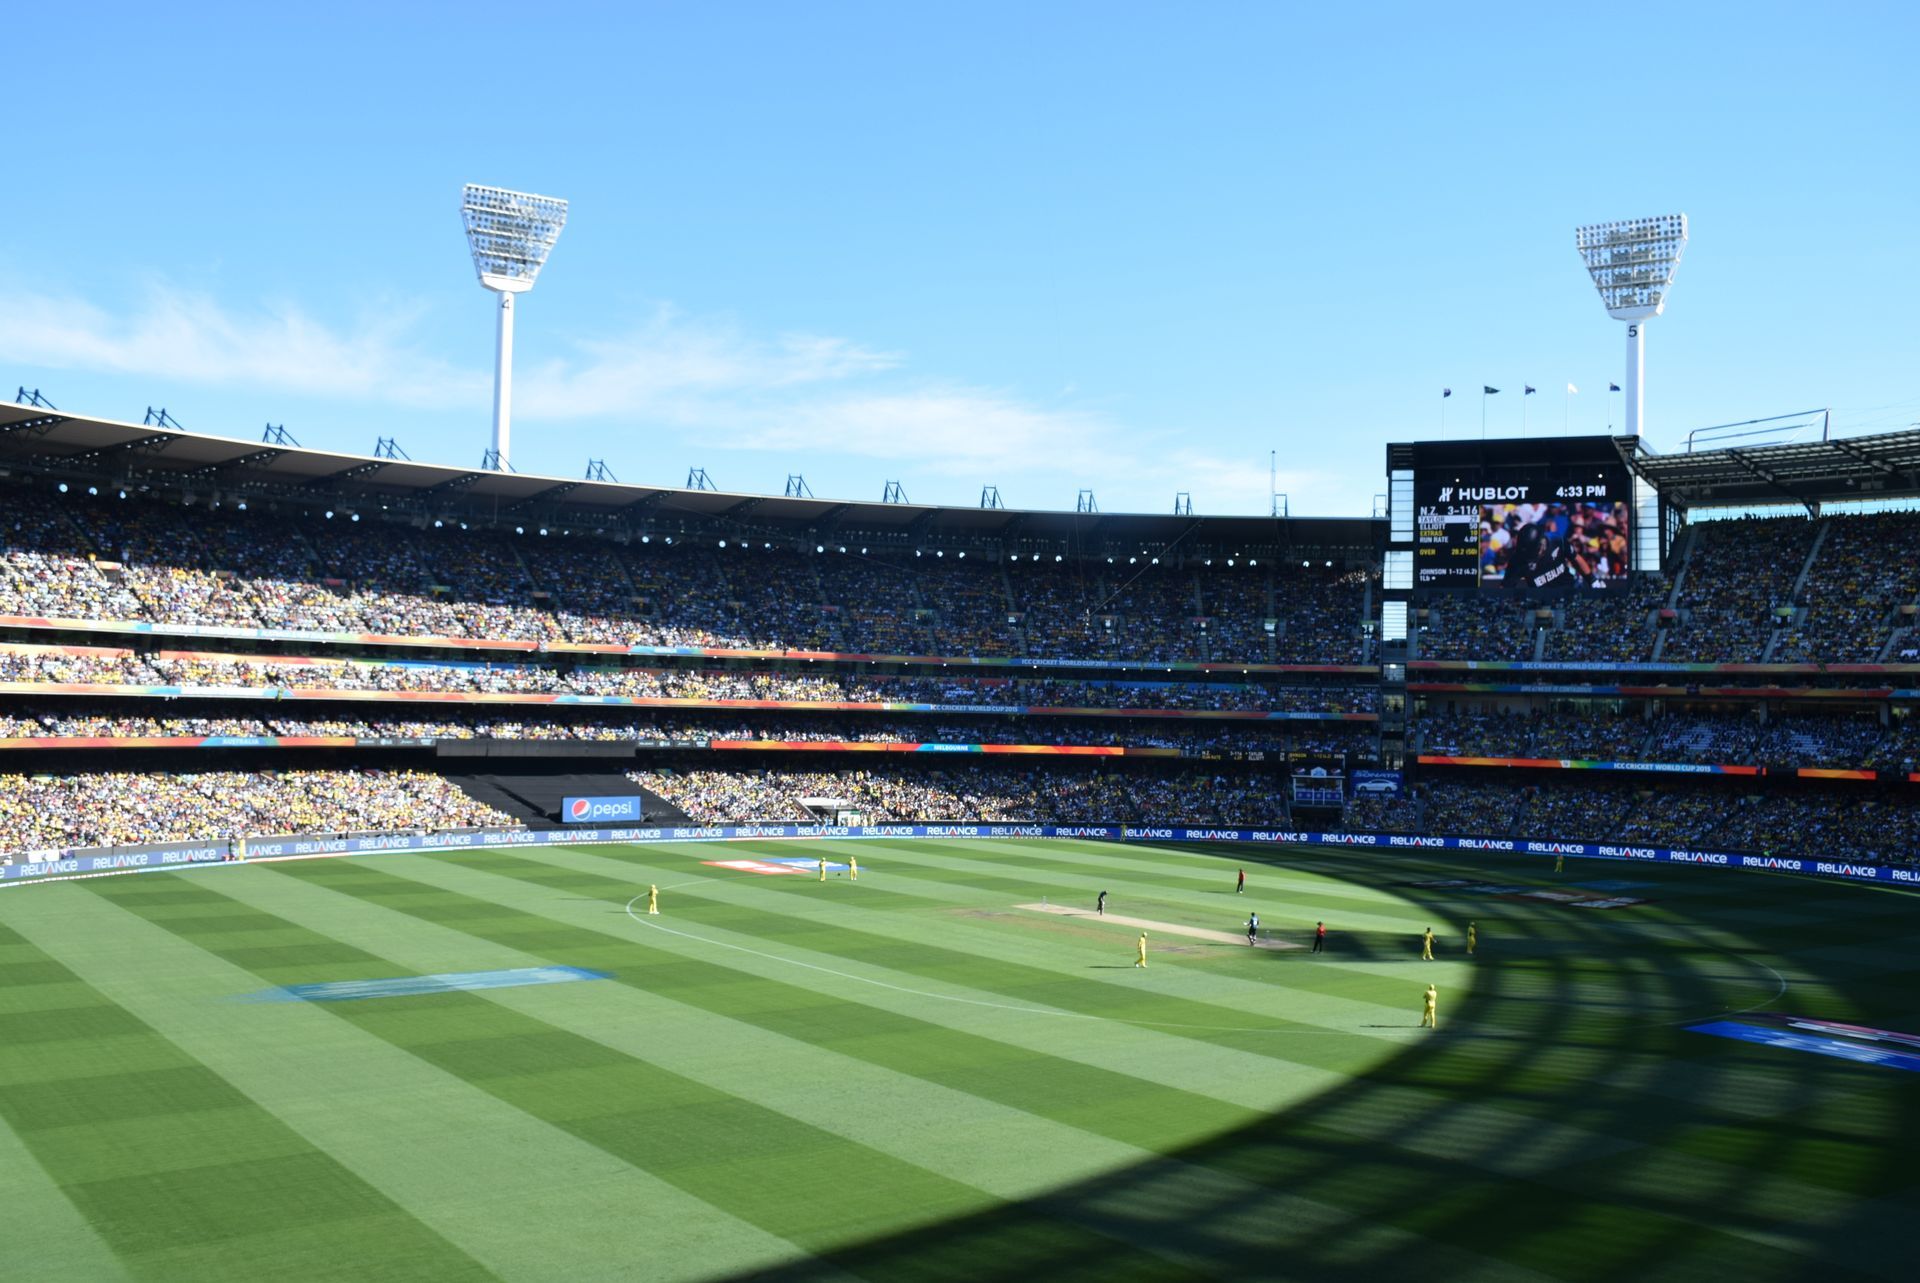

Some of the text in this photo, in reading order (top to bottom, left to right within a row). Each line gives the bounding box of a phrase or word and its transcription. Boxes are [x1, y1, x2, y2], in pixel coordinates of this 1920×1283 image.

[1628, 325, 1638, 337] 5
[1458, 486, 1529, 501] HUBLOT
[1556, 485, 1606, 498] 4:33 PM
[1419, 548, 1437, 556] OVER
[1533, 574, 1547, 588] NEW
[1625, 763, 1654, 771] CRICKET
[593, 801, 632, 817] pepsi
